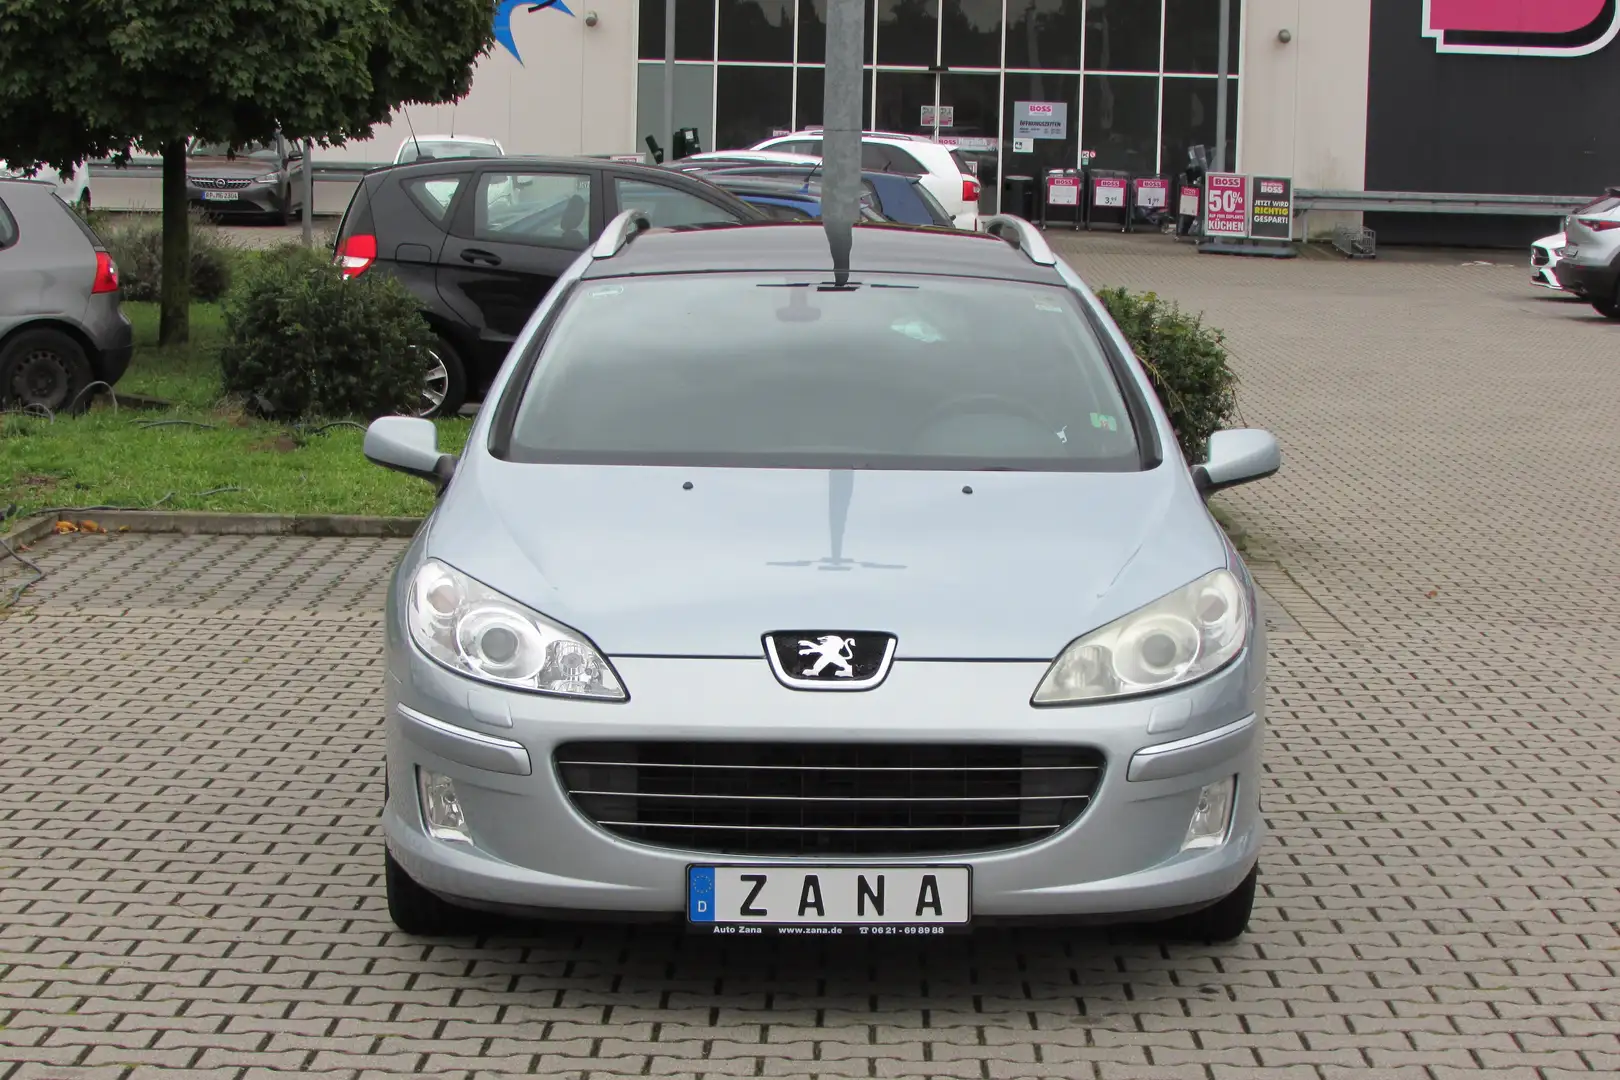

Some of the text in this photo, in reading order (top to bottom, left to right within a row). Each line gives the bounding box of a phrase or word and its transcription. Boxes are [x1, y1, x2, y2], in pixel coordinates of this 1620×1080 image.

[1214, 178, 1240, 186] BOSS
[1260, 185, 1284, 194] BOSS
[1208, 190, 1243, 213] 50%
[1254, 207, 1289, 215] RICHTIG
[1254, 215, 1288, 224] GESPART!
[1208, 218, 1244, 231] KÜCHEN
[698, 901, 707, 912] D
[713, 926, 736, 934] Auto
[738, 926, 762, 934] Zana
[778, 926, 843, 934] www.zana.de
